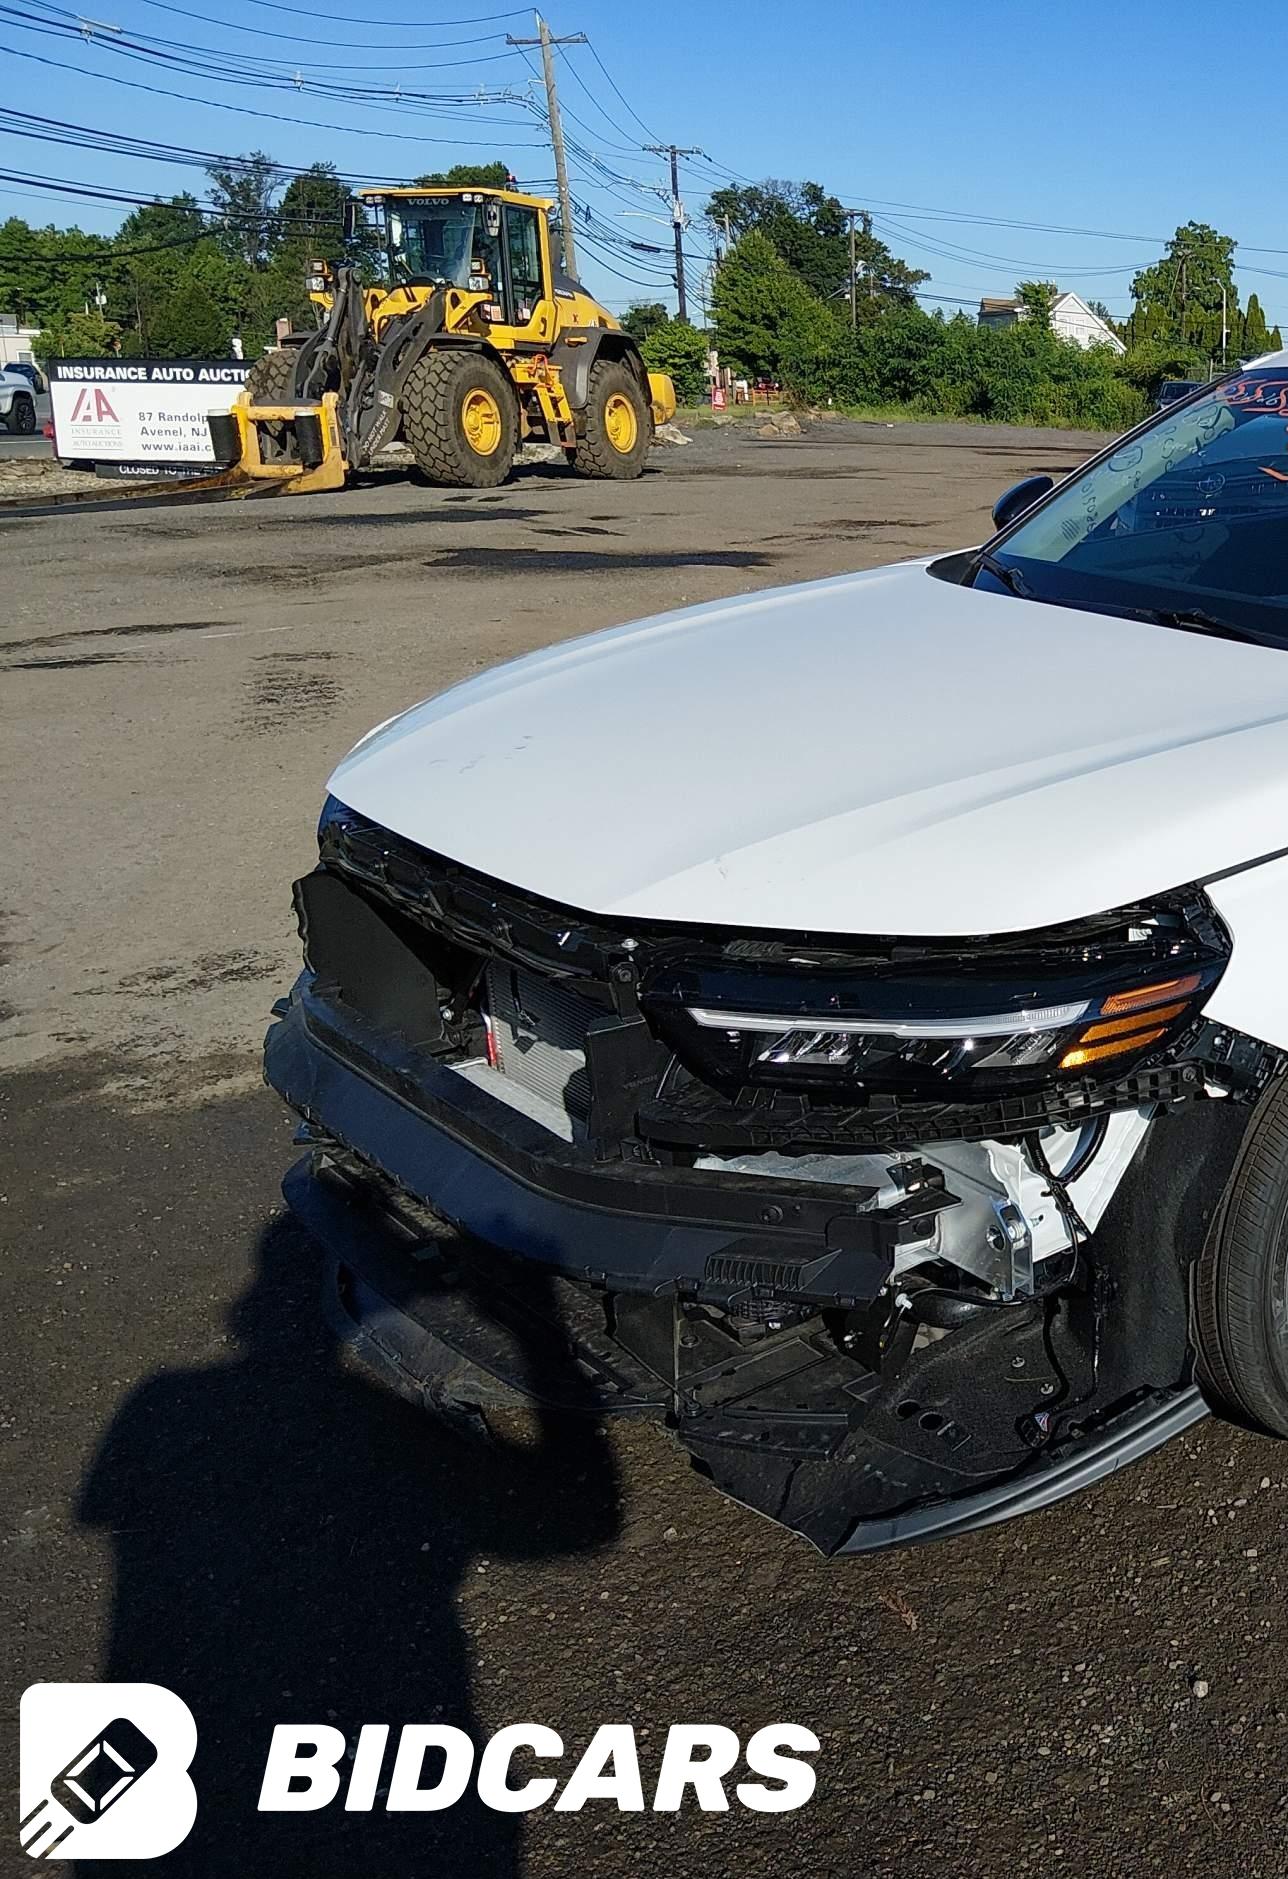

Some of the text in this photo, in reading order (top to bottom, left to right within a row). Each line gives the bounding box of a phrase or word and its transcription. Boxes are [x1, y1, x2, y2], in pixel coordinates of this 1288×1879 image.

[407, 198, 450, 206] VOLVO
[57, 366, 250, 382] INSURANCE AUTO AUCTI
[138, 411, 208, 425] 87 Randolp
[140, 426, 208, 438] Avenel, NJ
[141, 441, 212, 452] www.iaai.c
[119, 465, 160, 475] CLOSED
